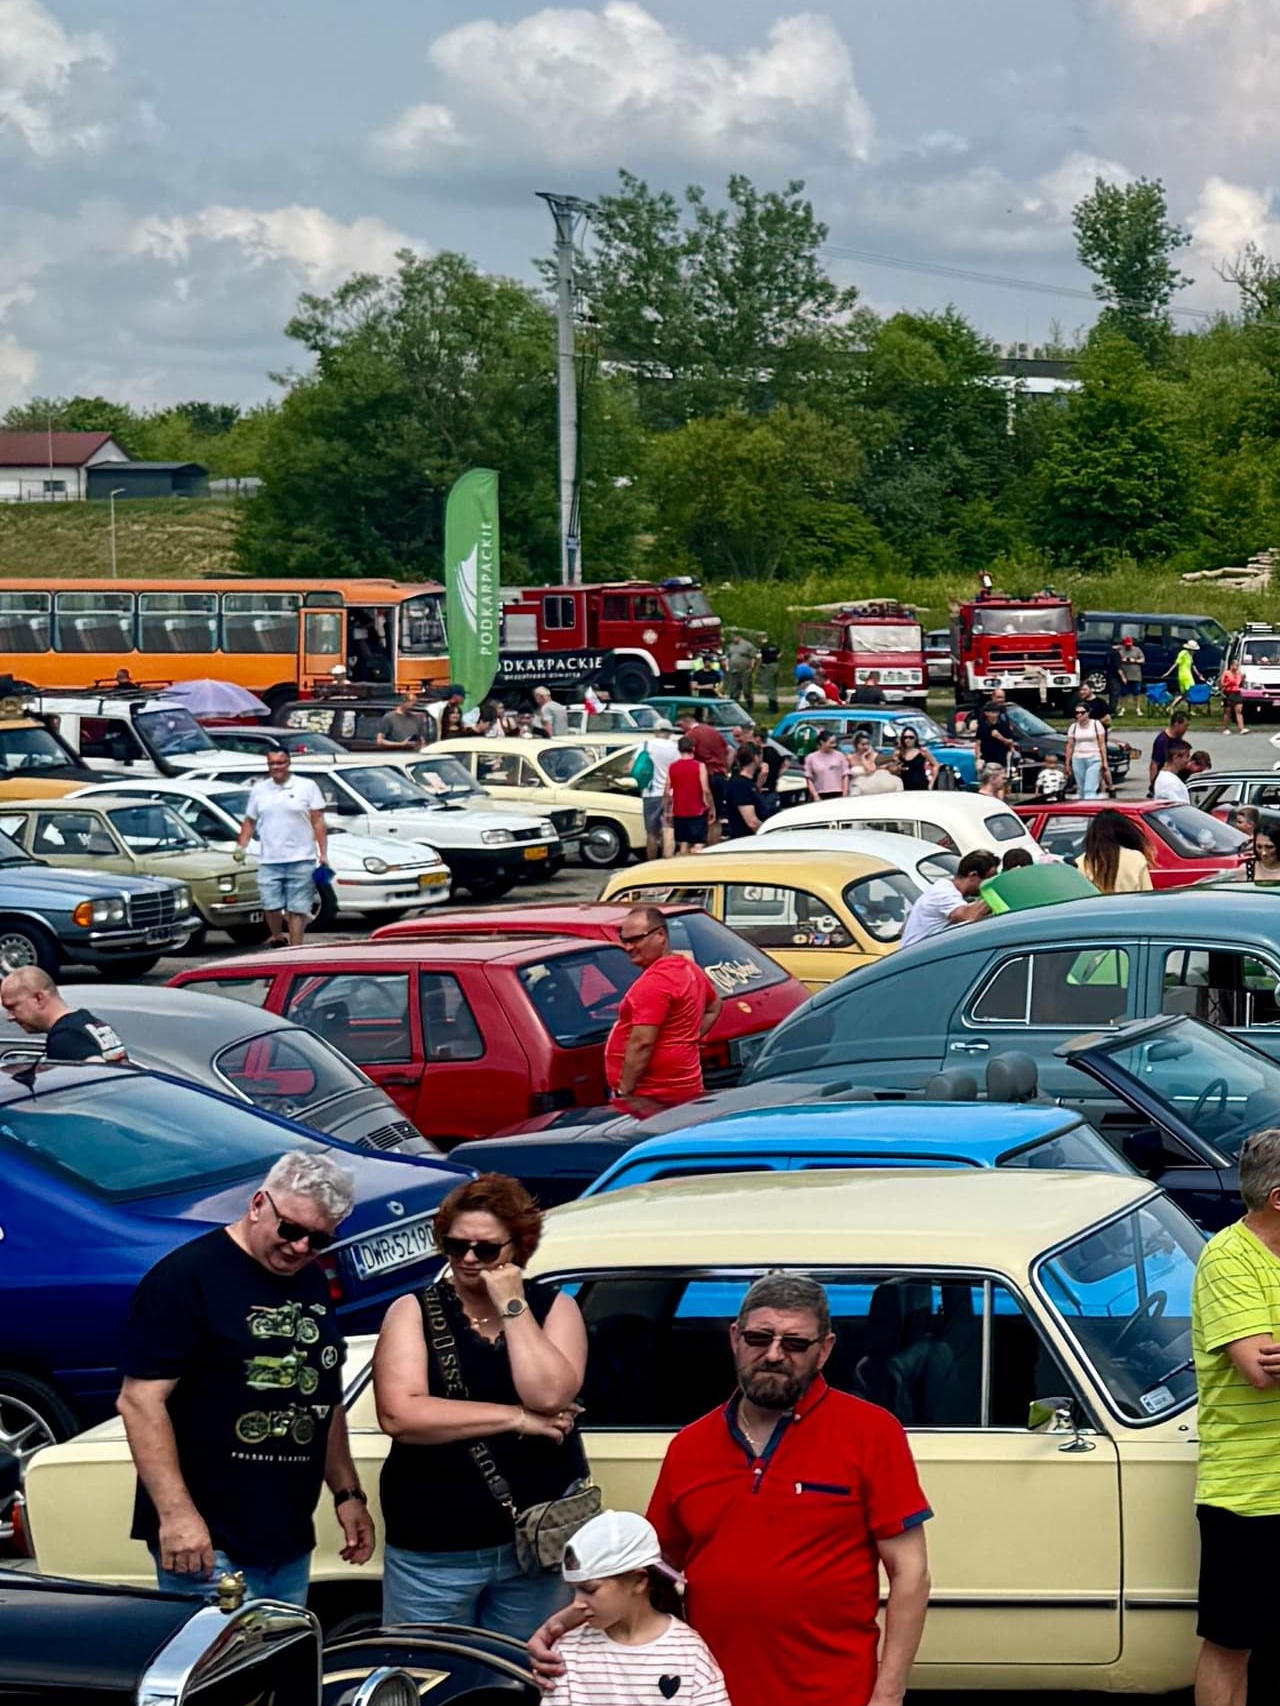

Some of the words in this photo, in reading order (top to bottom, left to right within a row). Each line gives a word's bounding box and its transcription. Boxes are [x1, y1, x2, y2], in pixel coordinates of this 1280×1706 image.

[481, 522, 493, 655] PODKARPACKIE
[496, 656, 603, 672] DKARPACKIE
[361, 1237, 394, 1269] DWR
